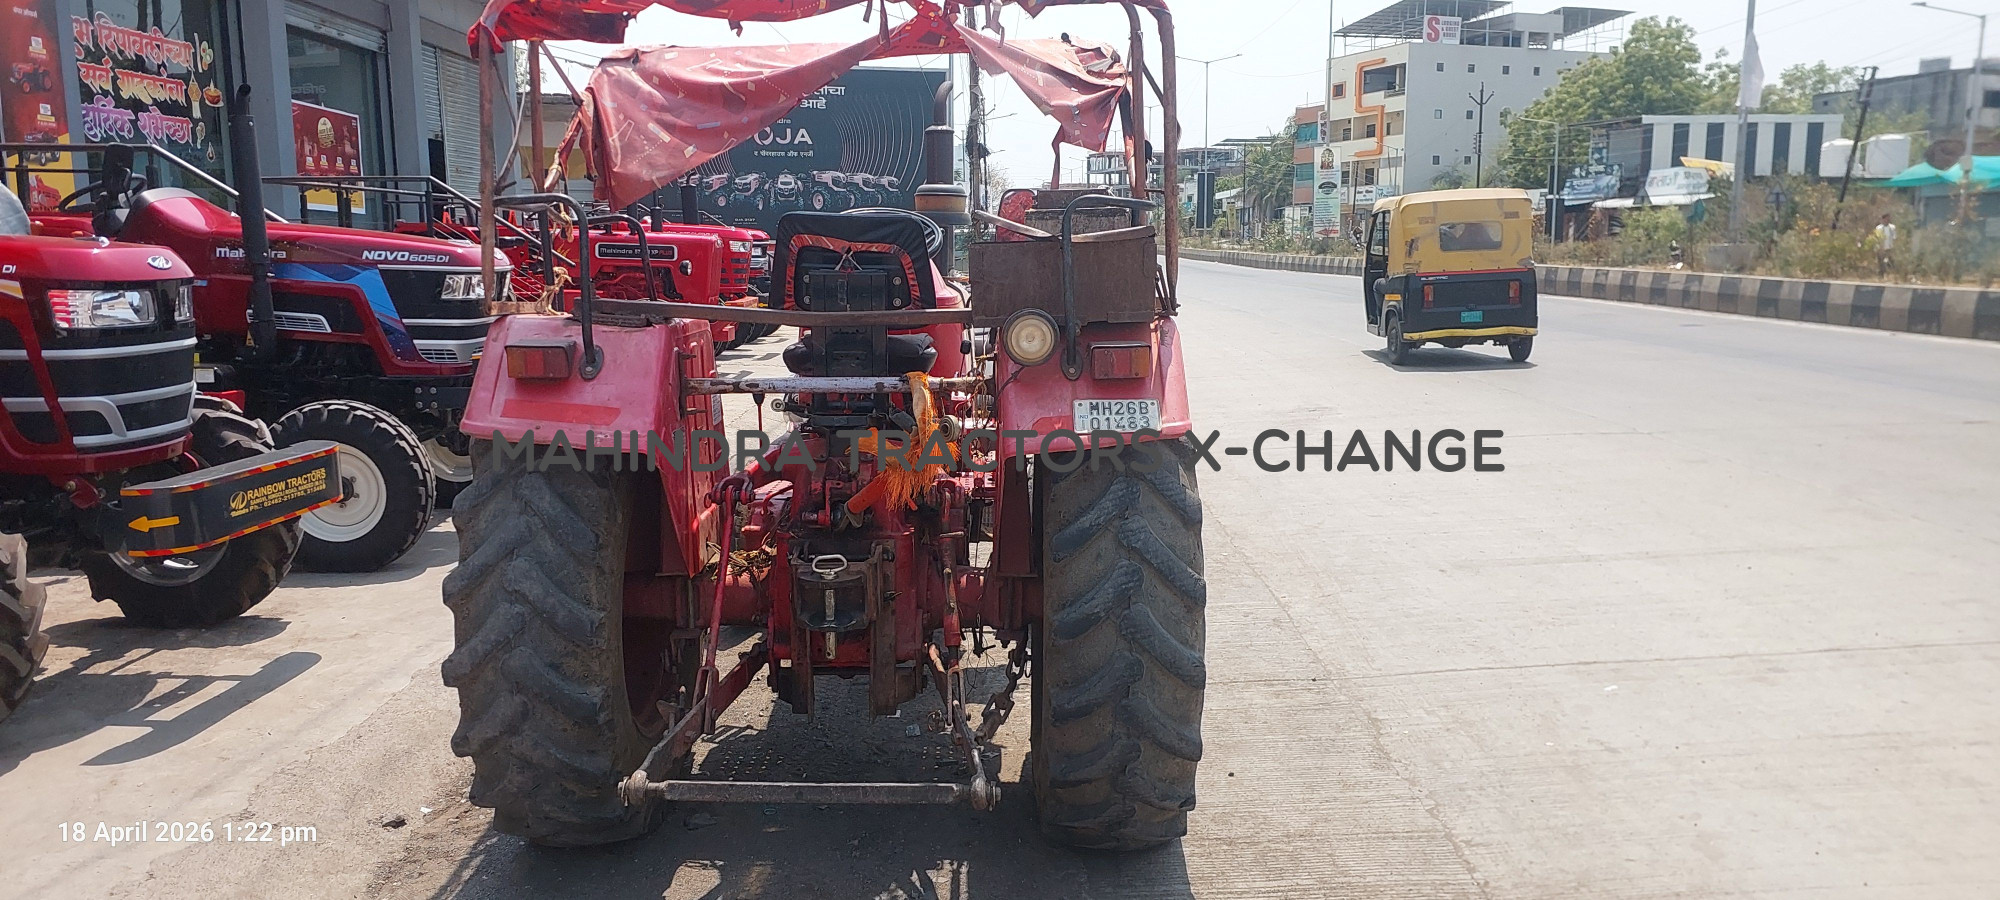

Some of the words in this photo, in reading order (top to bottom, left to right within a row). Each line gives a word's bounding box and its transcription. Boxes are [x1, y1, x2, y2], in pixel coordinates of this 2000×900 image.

[1427, 17, 1440, 42] S
[800, 97, 827, 109] आहे
[362, 250, 410, 263] NOVO
[600, 247, 633, 255] Mahindra
[1089, 401, 1149, 416] MH26B
[247, 481, 286, 500] RAINBOW
[286, 470, 326, 488] TRACTORS
